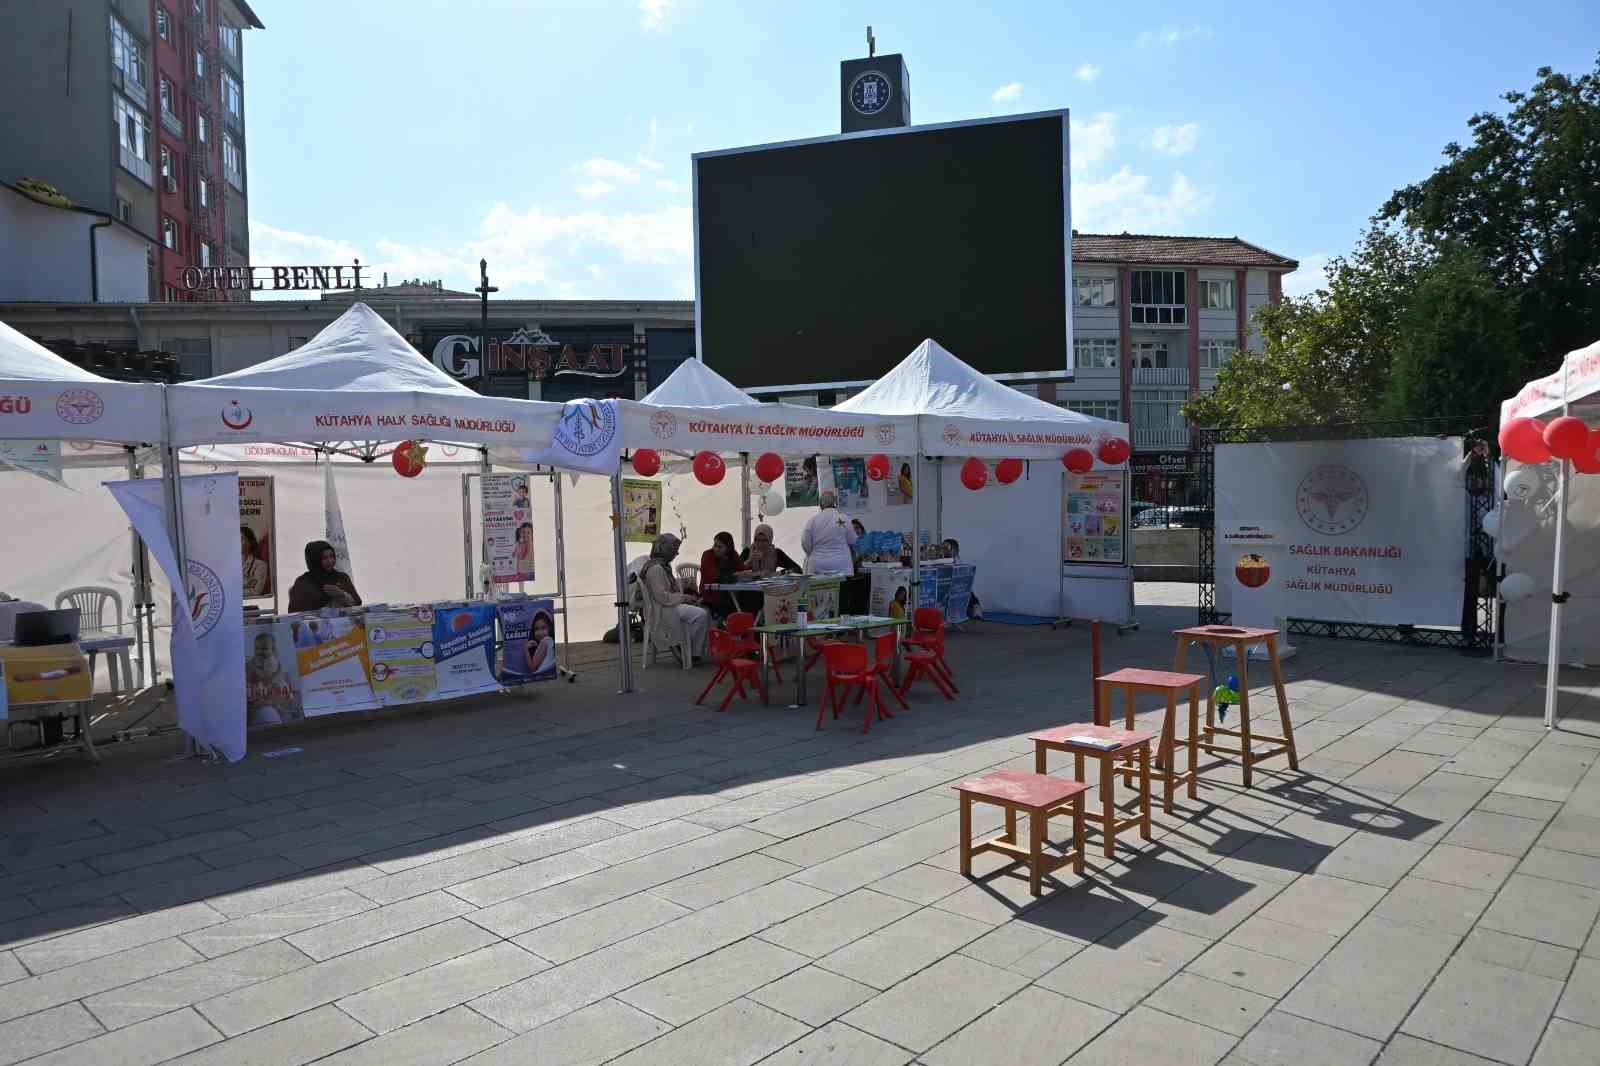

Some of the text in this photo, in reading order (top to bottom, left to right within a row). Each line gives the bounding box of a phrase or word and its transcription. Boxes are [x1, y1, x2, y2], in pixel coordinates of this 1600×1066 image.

[183, 258, 363, 290] OTEL BENLİ
[315, 414, 372, 427] KÜTAHYA
[377, 414, 405, 427] HALK
[689, 421, 864, 438] KÜTAHYA İL SAĞLIK MÜDÜRLÜĞÜ
[1289, 543, 1403, 559] SAĞLIK BAKANLIĞI
[1306, 564, 1357, 576] KÜTAHYA
[1324, 581, 1393, 594] MÜDÜRLÜĞÜ
